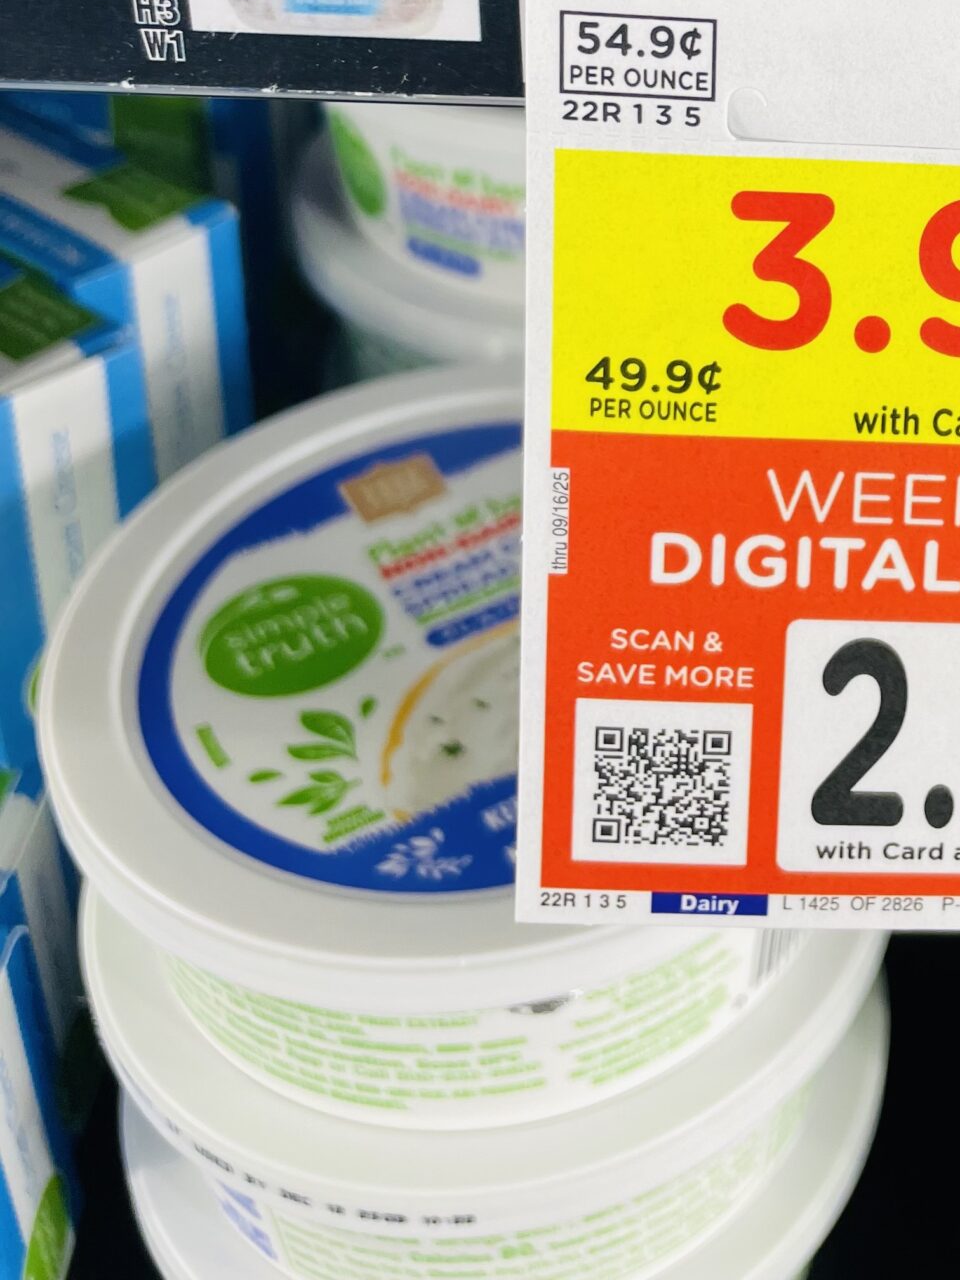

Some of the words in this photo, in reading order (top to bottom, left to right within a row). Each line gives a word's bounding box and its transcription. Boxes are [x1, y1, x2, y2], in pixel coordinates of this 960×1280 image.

[139, 28, 187, 62] W1
[577, 21, 702, 61] 54.9¢
[570, 65, 614, 87] PER
[624, 68, 709, 92] OUNCE
[562, 99, 622, 124] 22R
[585, 356, 723, 395] 49.9¢
[590, 397, 632, 419] PER
[639, 399, 718, 423] OUNCE
[854, 405, 920, 436] with
[552, 471, 570, 539] 09/16/25
[552, 541, 569, 572] thru
[226, 592, 352, 651] simple
[232, 613, 368, 677] truth
[610, 628, 695, 653] SCAN
[704, 631, 723, 654] &
[577, 661, 656, 686] SAVE
[664, 665, 754, 689] MORE
[816, 840, 872, 862] with
[883, 842, 944, 862] Card
[540, 892, 576, 907] 22R
[680, 894, 739, 914] Dairy
[782, 896, 792, 910] L
[800, 897, 840, 911] 1425
[850, 897, 876, 911] OF
[881, 897, 924, 911] 2826
